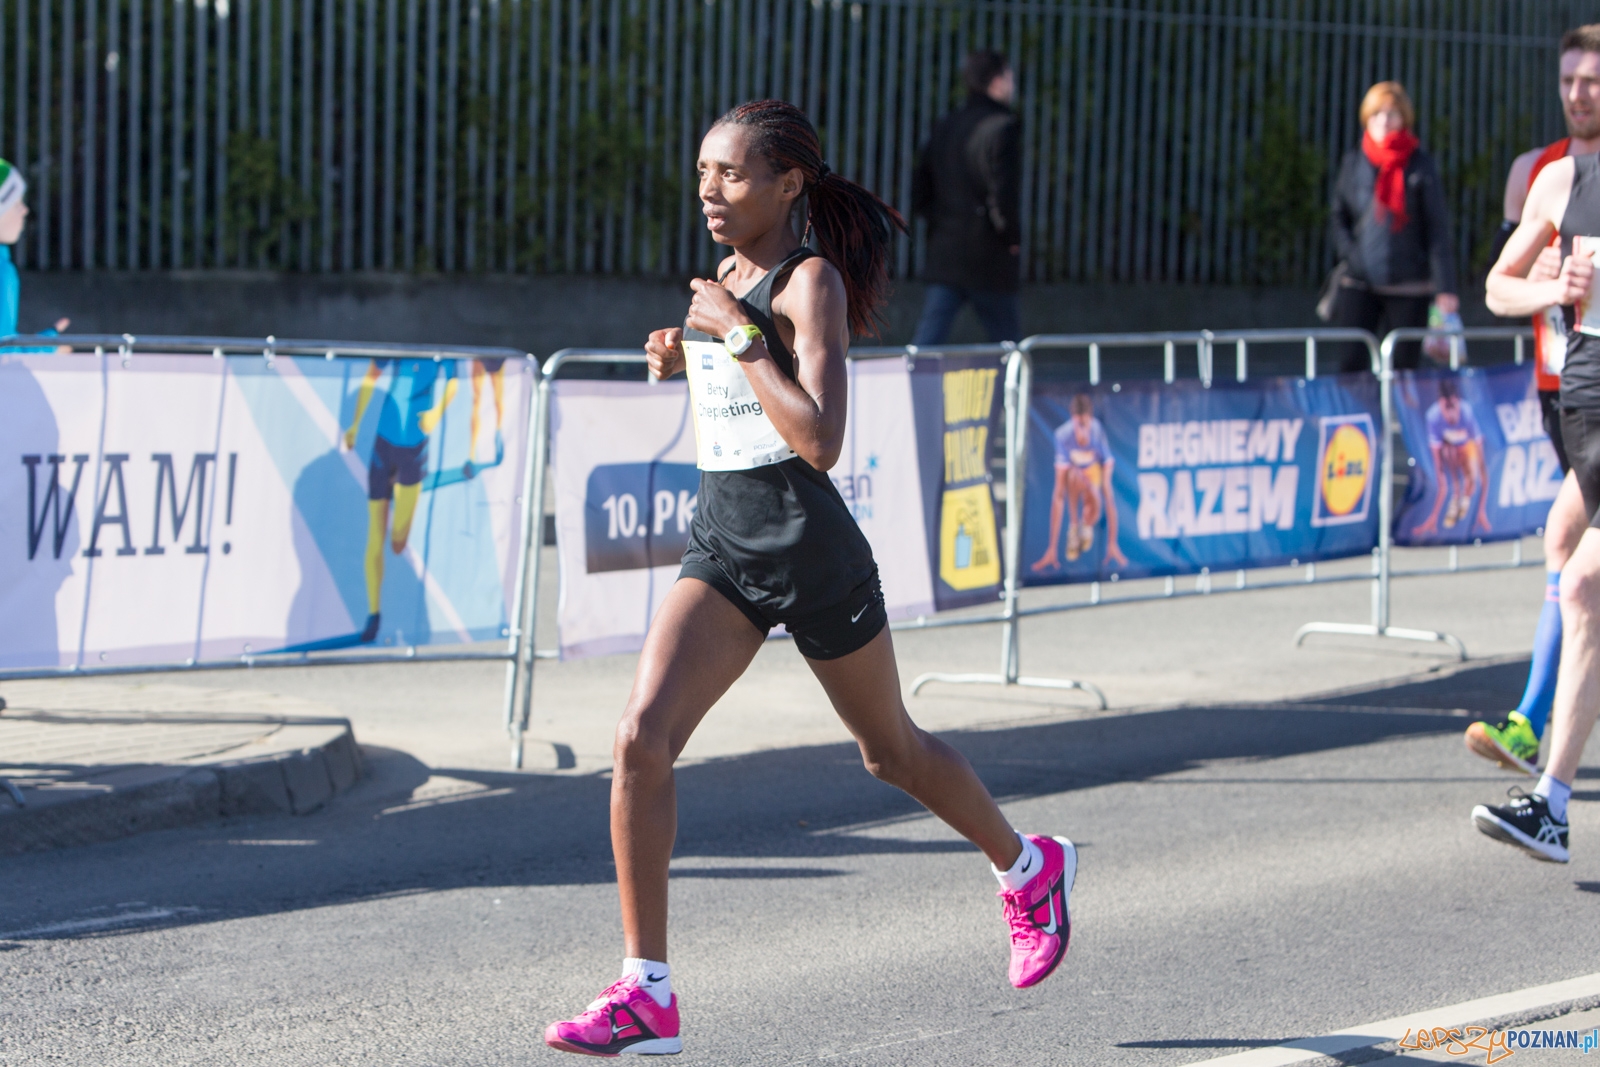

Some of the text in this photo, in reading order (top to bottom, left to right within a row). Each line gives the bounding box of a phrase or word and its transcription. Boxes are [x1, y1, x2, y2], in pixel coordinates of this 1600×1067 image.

[707, 382, 729, 398] Betty
[1137, 418, 1304, 469] BIEGNIEMY
[22, 452, 238, 561] WAM!
[1136, 464, 1300, 540] RAZEM
